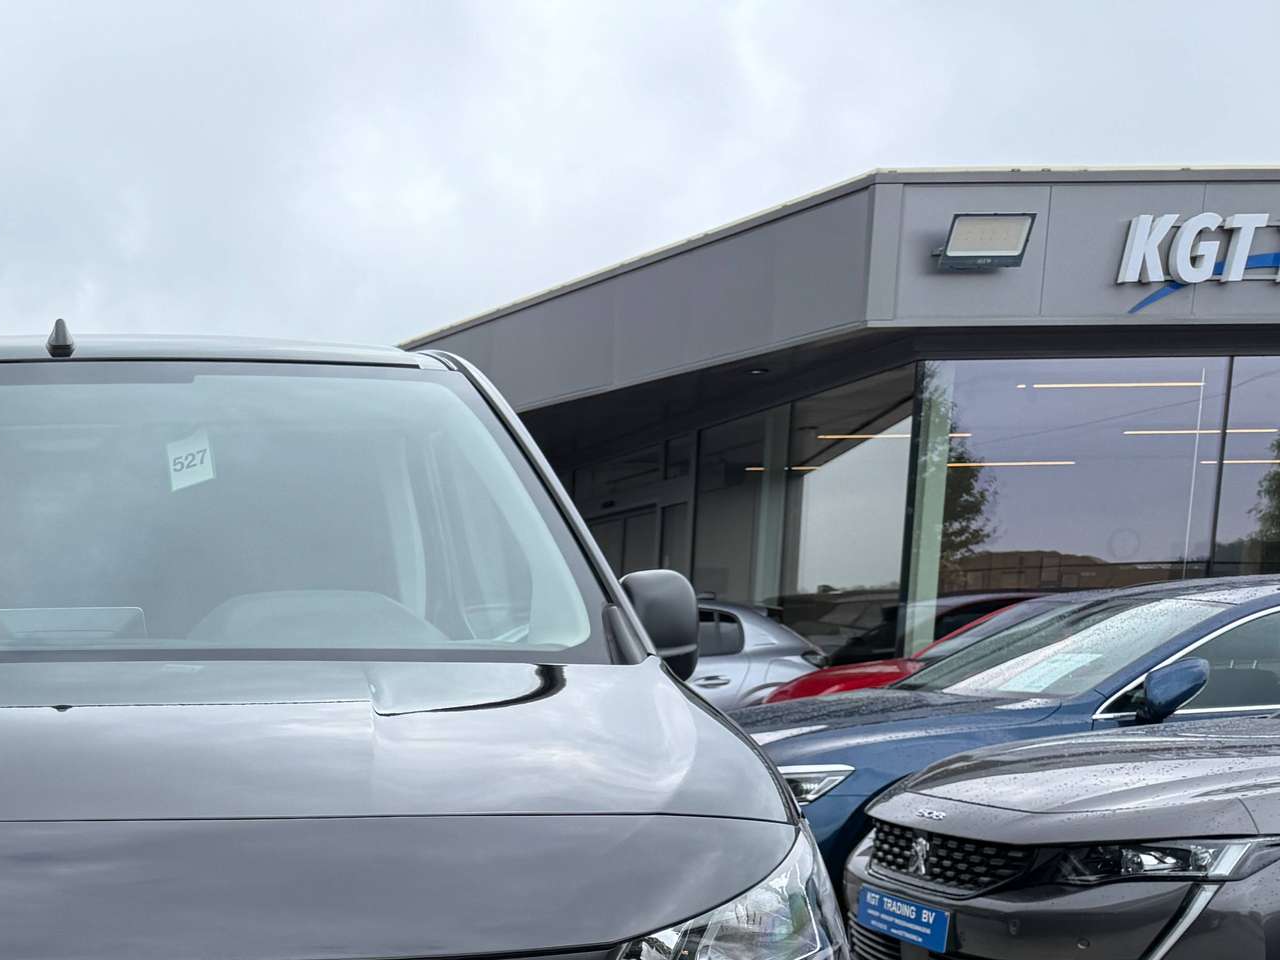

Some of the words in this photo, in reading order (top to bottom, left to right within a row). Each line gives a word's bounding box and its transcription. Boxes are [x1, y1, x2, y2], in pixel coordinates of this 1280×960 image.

[1117, 212, 1270, 284] KGT
[172, 448, 207, 472] 527
[882, 897, 916, 919] TRADING
[921, 909, 936, 924] BV
